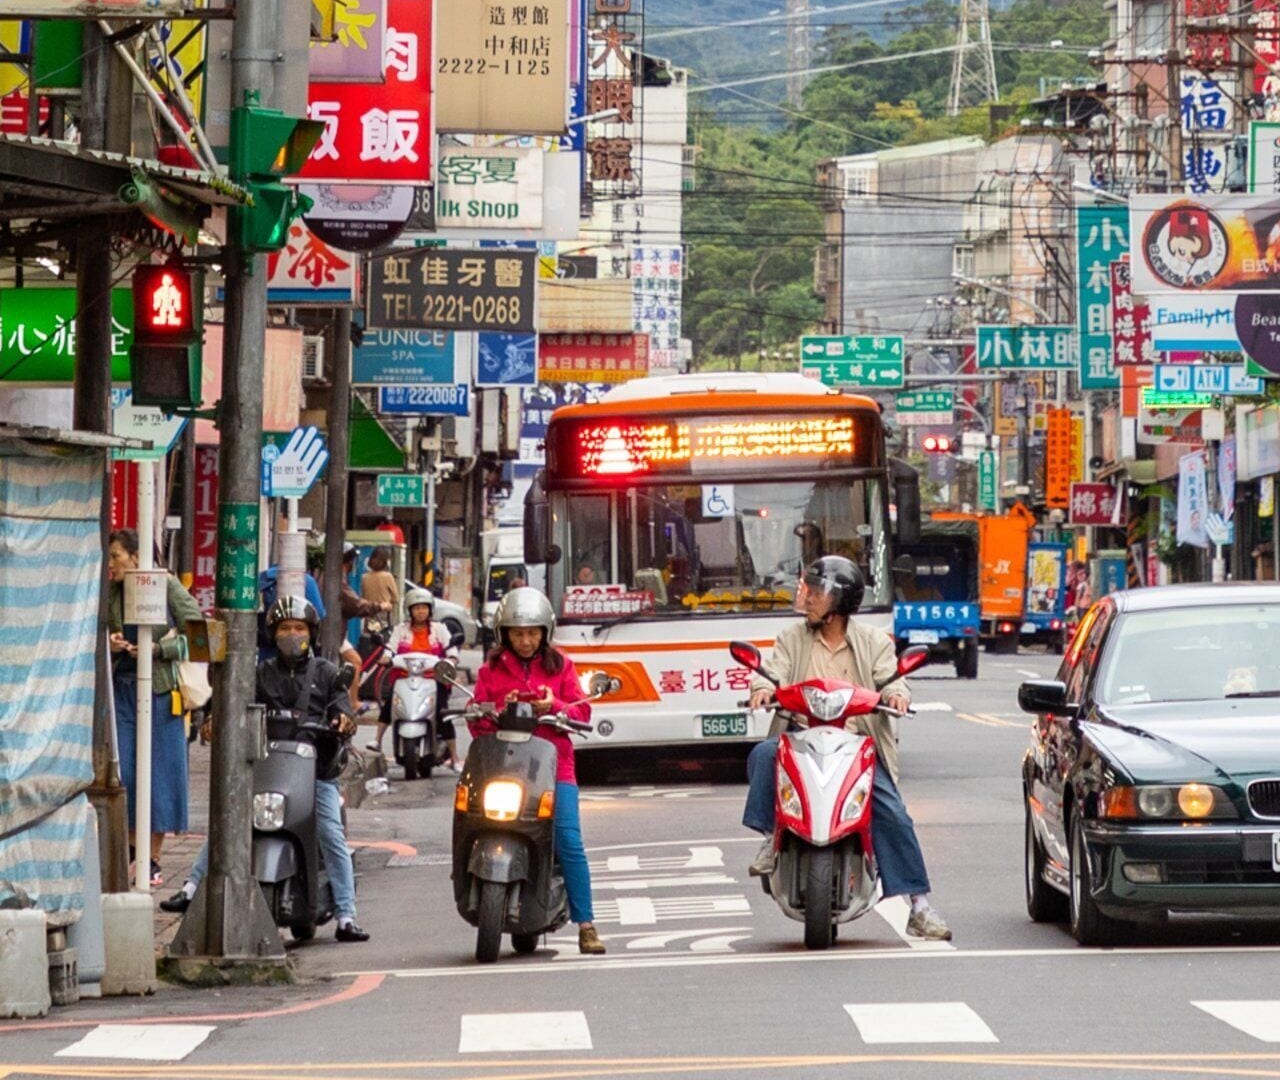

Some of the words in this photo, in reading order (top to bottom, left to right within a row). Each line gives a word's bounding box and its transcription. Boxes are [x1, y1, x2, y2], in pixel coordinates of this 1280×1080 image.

[489, 5, 550, 26] 造型館
[484, 33, 551, 57] 中和店
[437, 58, 551, 76] 2222-1125
[467, 199, 519, 220] Shop
[382, 256, 523, 288] 虹佳牙醫
[382, 293, 417, 320] TEL
[423, 294, 521, 324] 2221-0268
[1157, 307, 1233, 328] FamilyM
[391, 350, 416, 361] SPA
